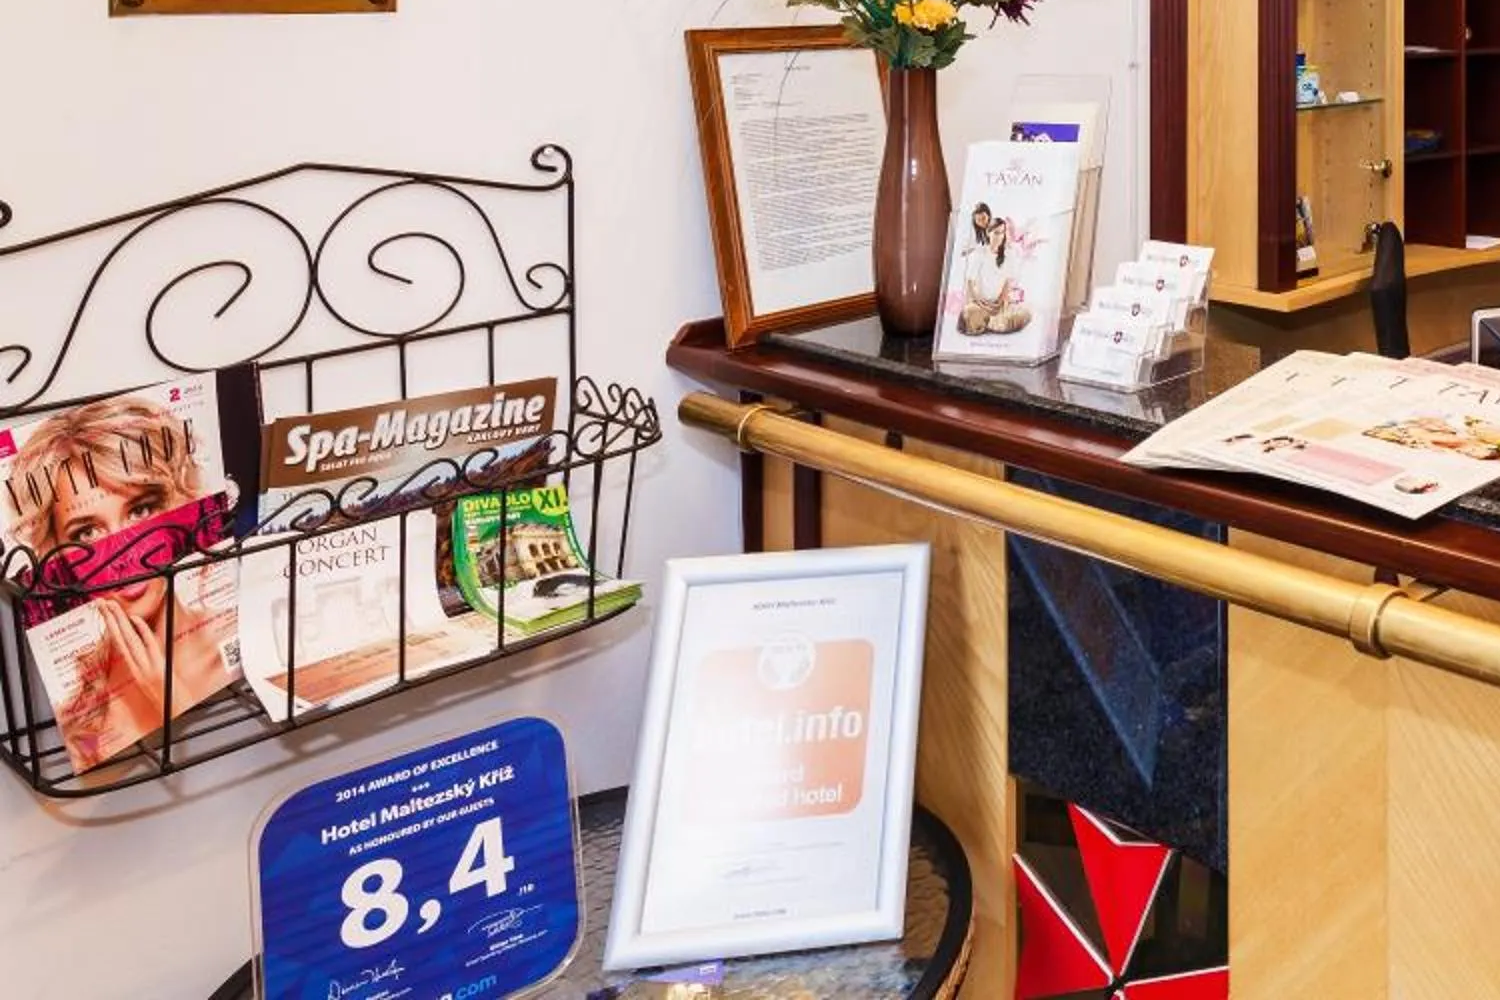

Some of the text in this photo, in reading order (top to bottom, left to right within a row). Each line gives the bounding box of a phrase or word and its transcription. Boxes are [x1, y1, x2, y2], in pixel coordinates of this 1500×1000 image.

[169, 387, 181, 403] 2
[284, 393, 547, 473] Spa-Magazine
[282, 545, 391, 579] CONCERT
[297, 526, 377, 556] ORGAN
[335, 739, 499, 802] 2014 AWARD OF EXCELLENCE
[320, 764, 515, 845] Hotel Maltezský Kříž
[349, 796, 495, 856] AS HONOURED BY OUR GUESTS
